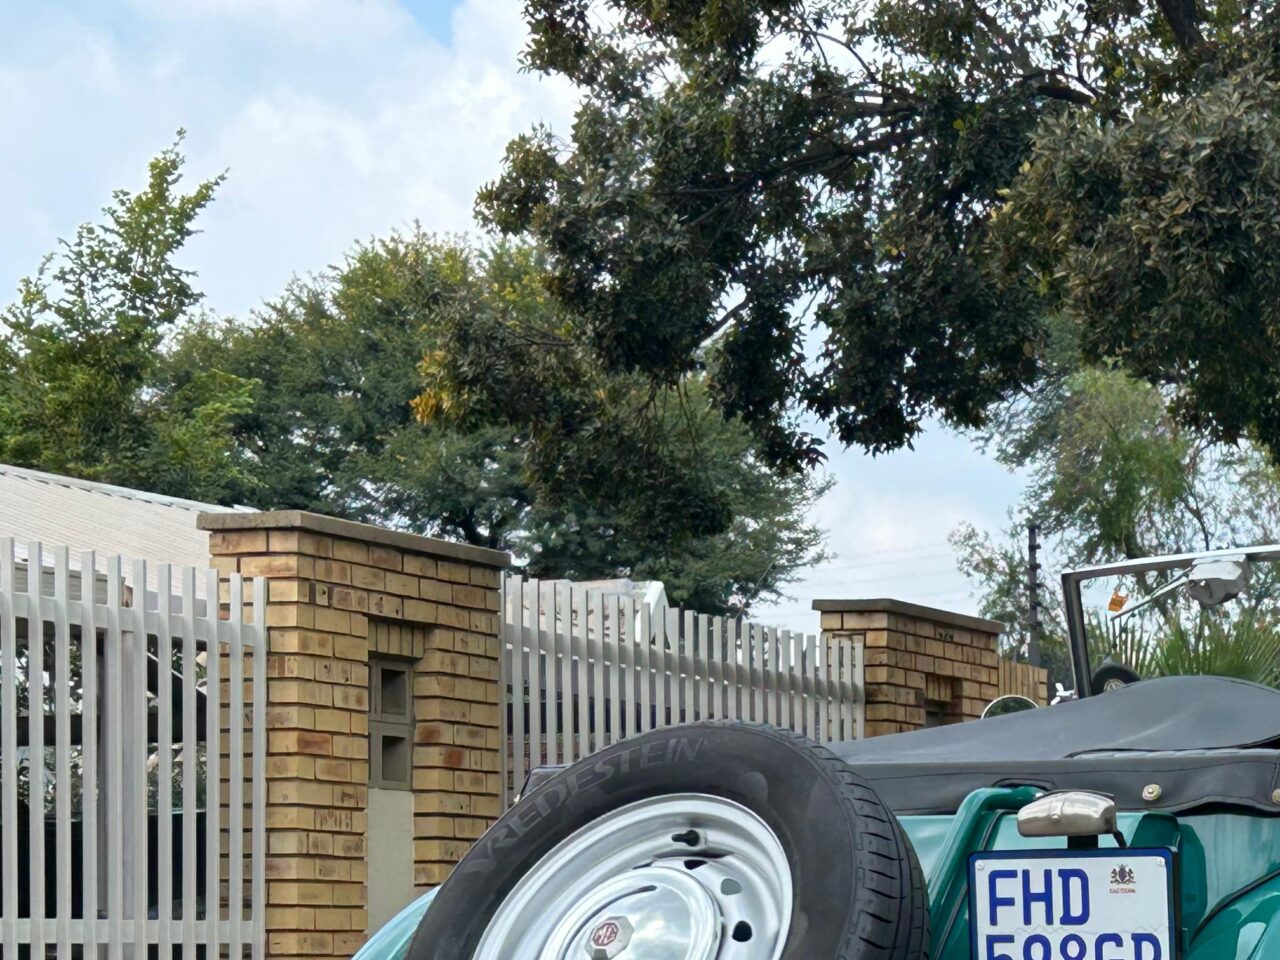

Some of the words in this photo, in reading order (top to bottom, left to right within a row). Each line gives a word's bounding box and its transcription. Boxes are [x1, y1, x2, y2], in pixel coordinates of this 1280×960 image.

[465, 737, 706, 875] VREDESTEIN
[988, 869, 1090, 926] FHD
[594, 923, 618, 946] MG
